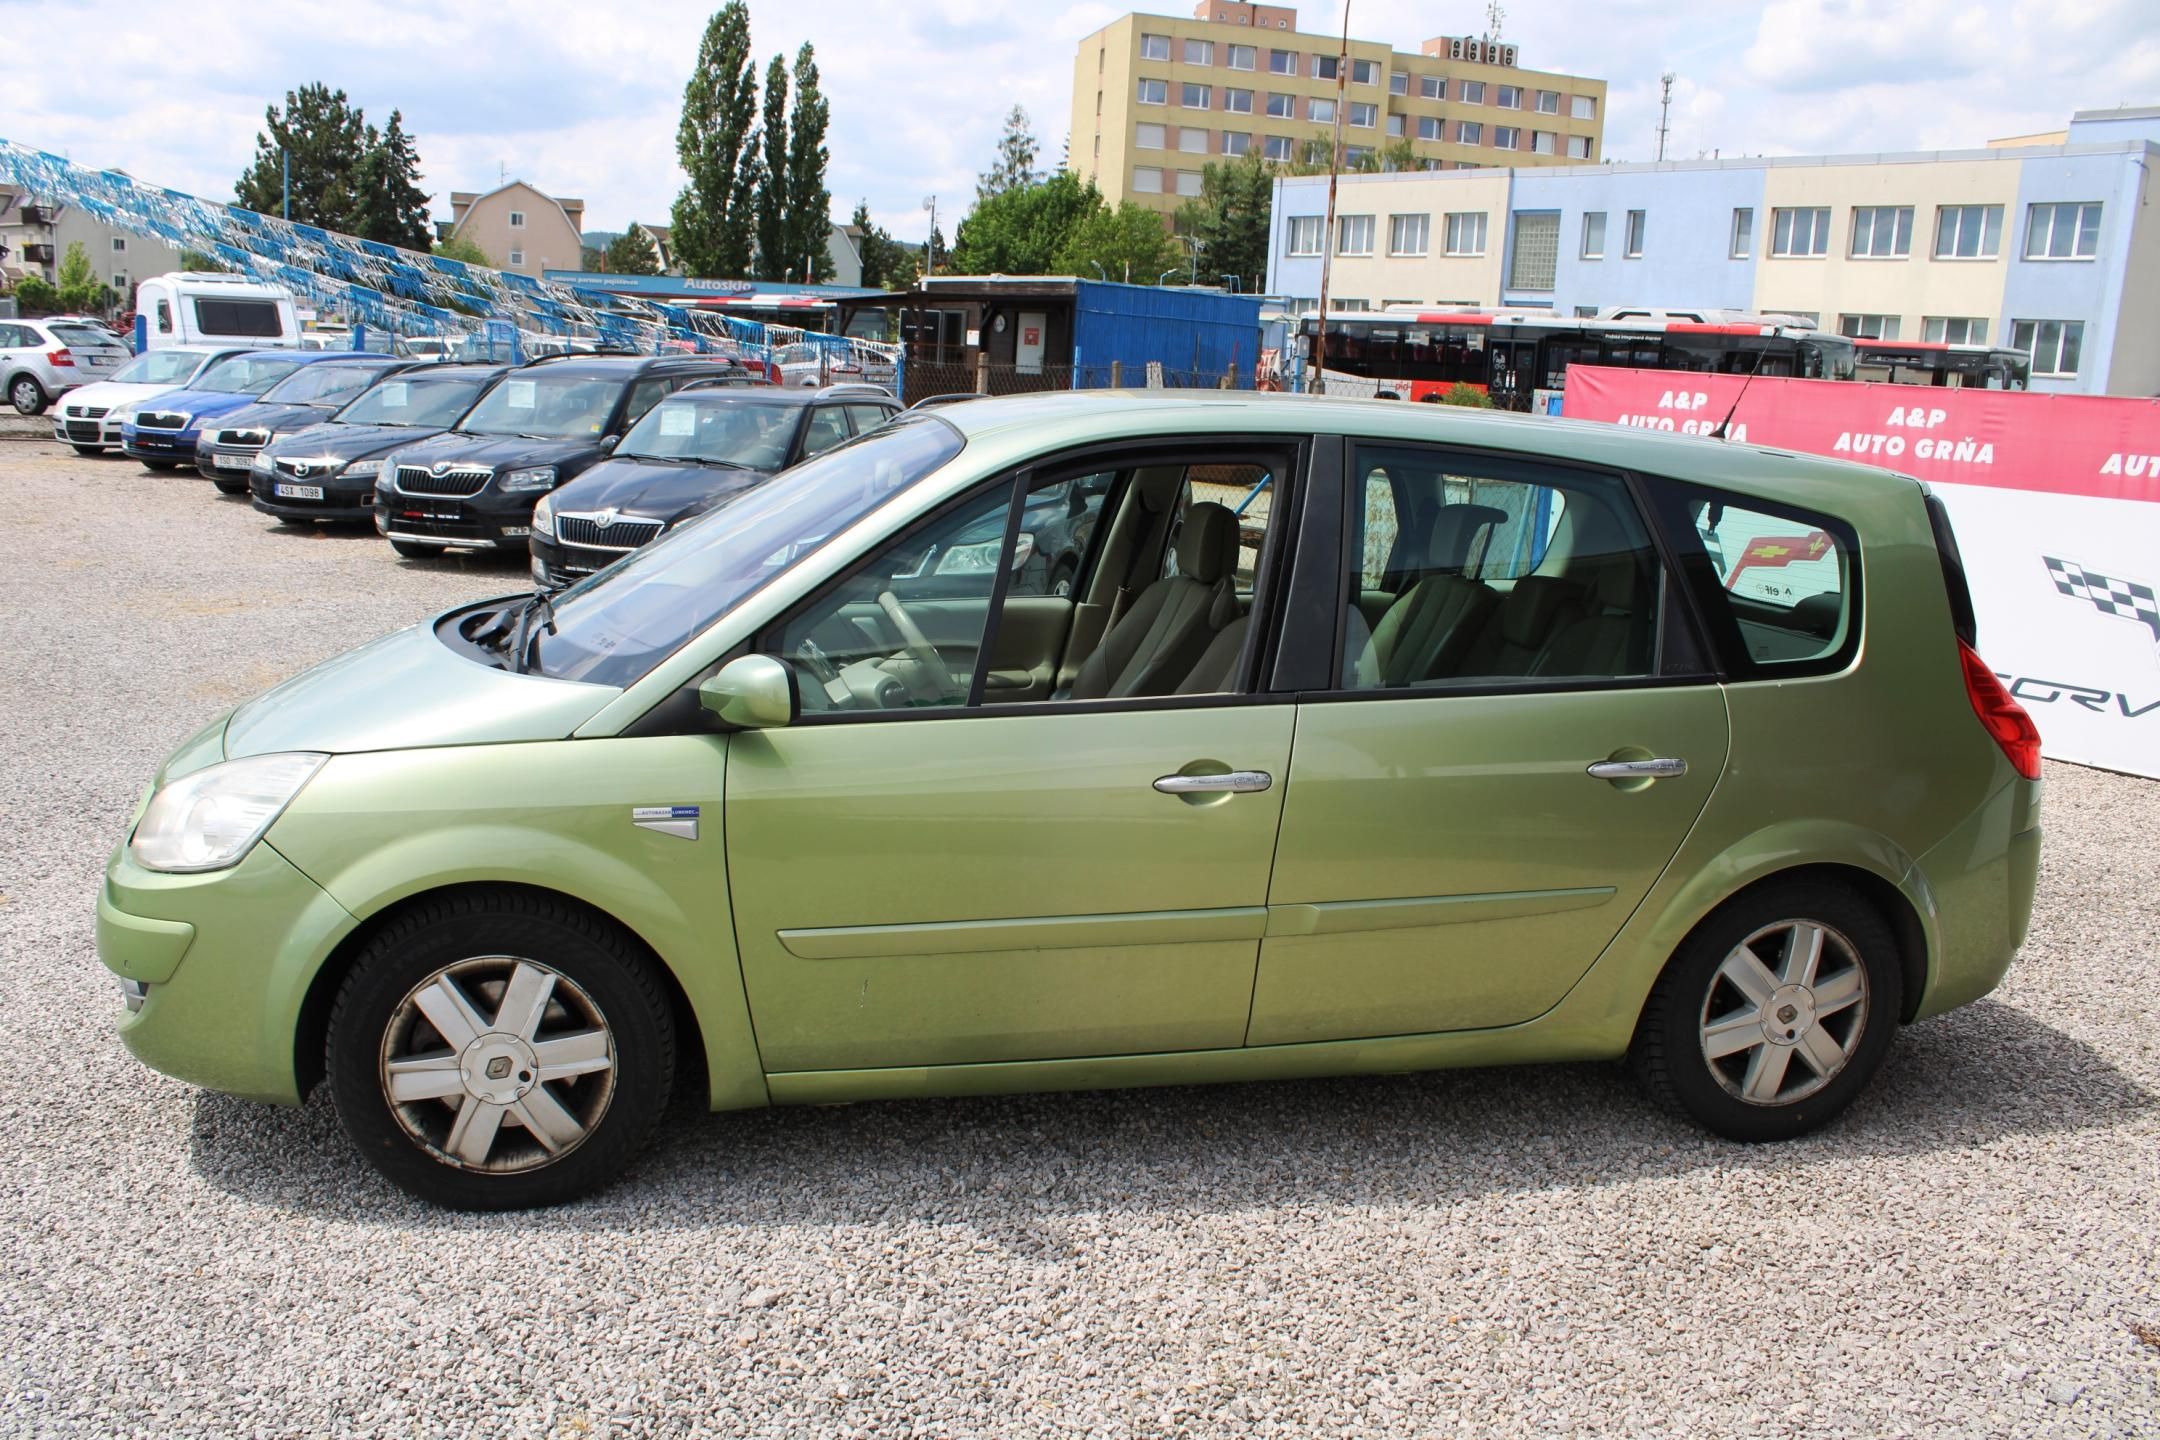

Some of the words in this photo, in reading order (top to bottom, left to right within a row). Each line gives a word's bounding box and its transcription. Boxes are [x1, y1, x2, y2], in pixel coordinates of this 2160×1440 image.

[683, 278, 751, 291] Autosklo
[1658, 390, 1708, 410] A&P
[1886, 406, 1947, 429] A&P
[1832, 431, 1906, 456] AUTO
[1914, 436, 1994, 464] GRŇA
[280, 485, 294, 496] 4SX
[300, 487, 320, 498] 1098
